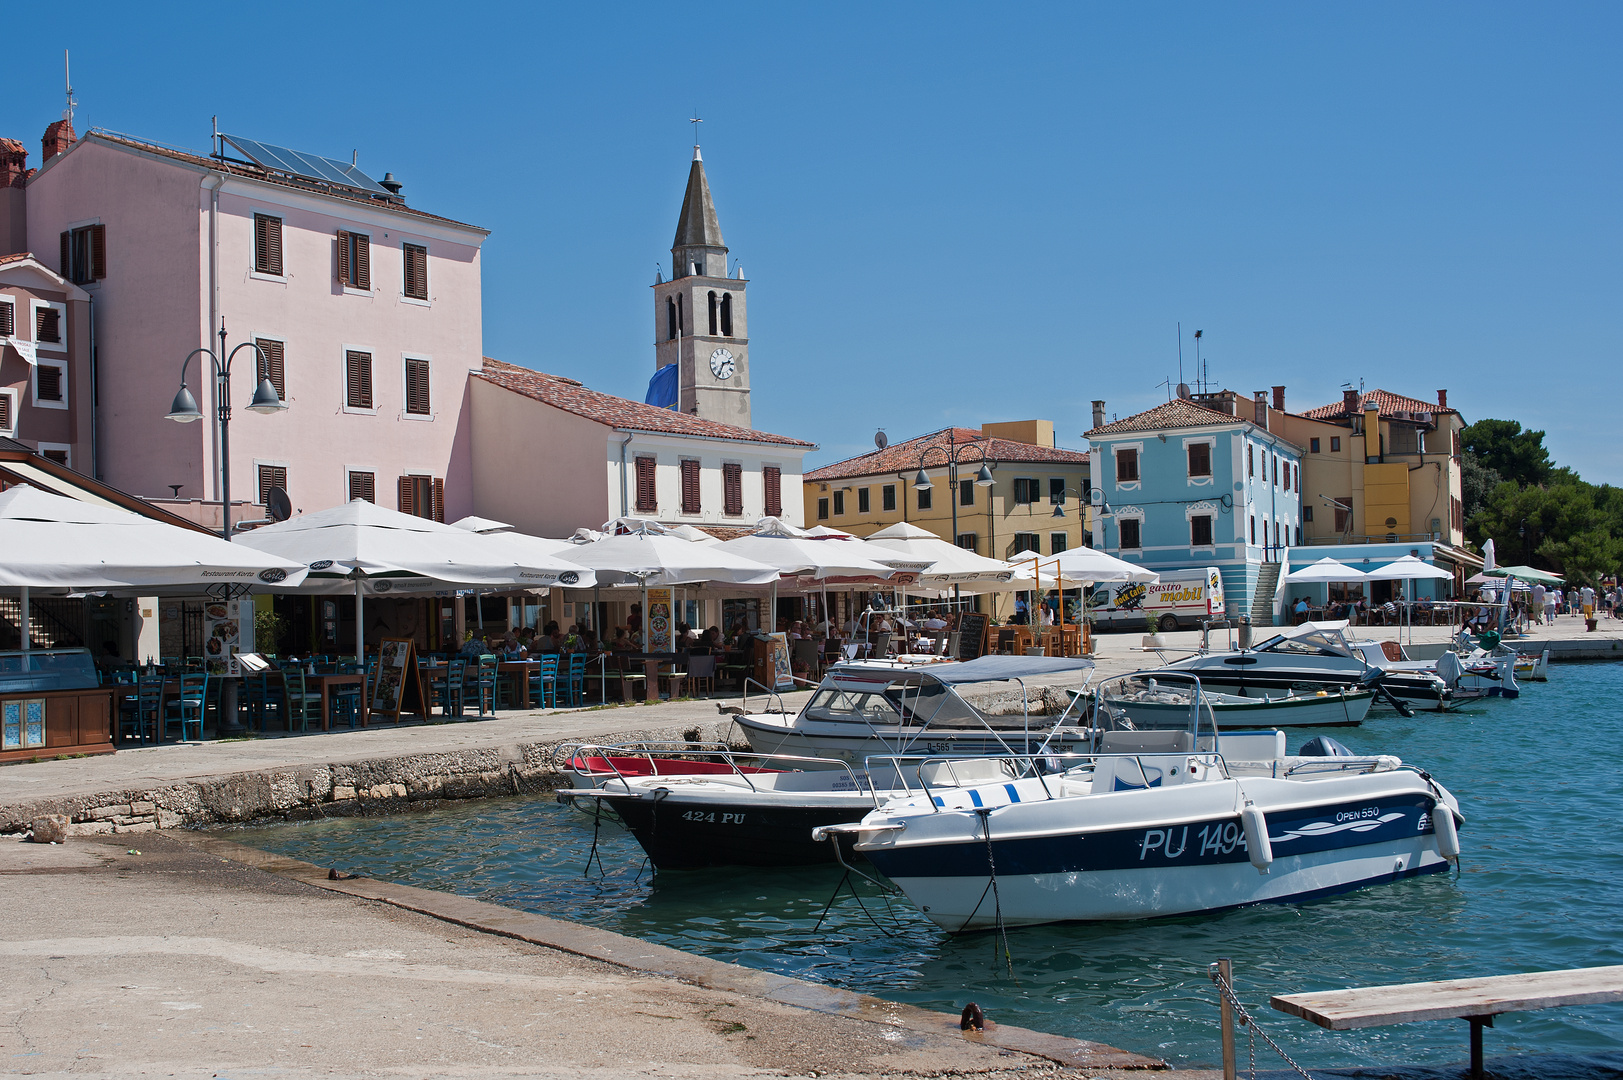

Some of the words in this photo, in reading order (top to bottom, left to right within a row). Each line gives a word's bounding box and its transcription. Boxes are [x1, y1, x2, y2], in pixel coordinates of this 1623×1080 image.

[1148, 583, 1182, 595] gastro
[1160, 586, 1203, 602] mobil
[1113, 593, 1130, 607] Rock
[682, 810, 716, 823] 424
[721, 812, 746, 825] PU
[1361, 806, 1379, 818] 550
[1140, 826, 1188, 860] PU
[1198, 822, 1248, 857] 1494
